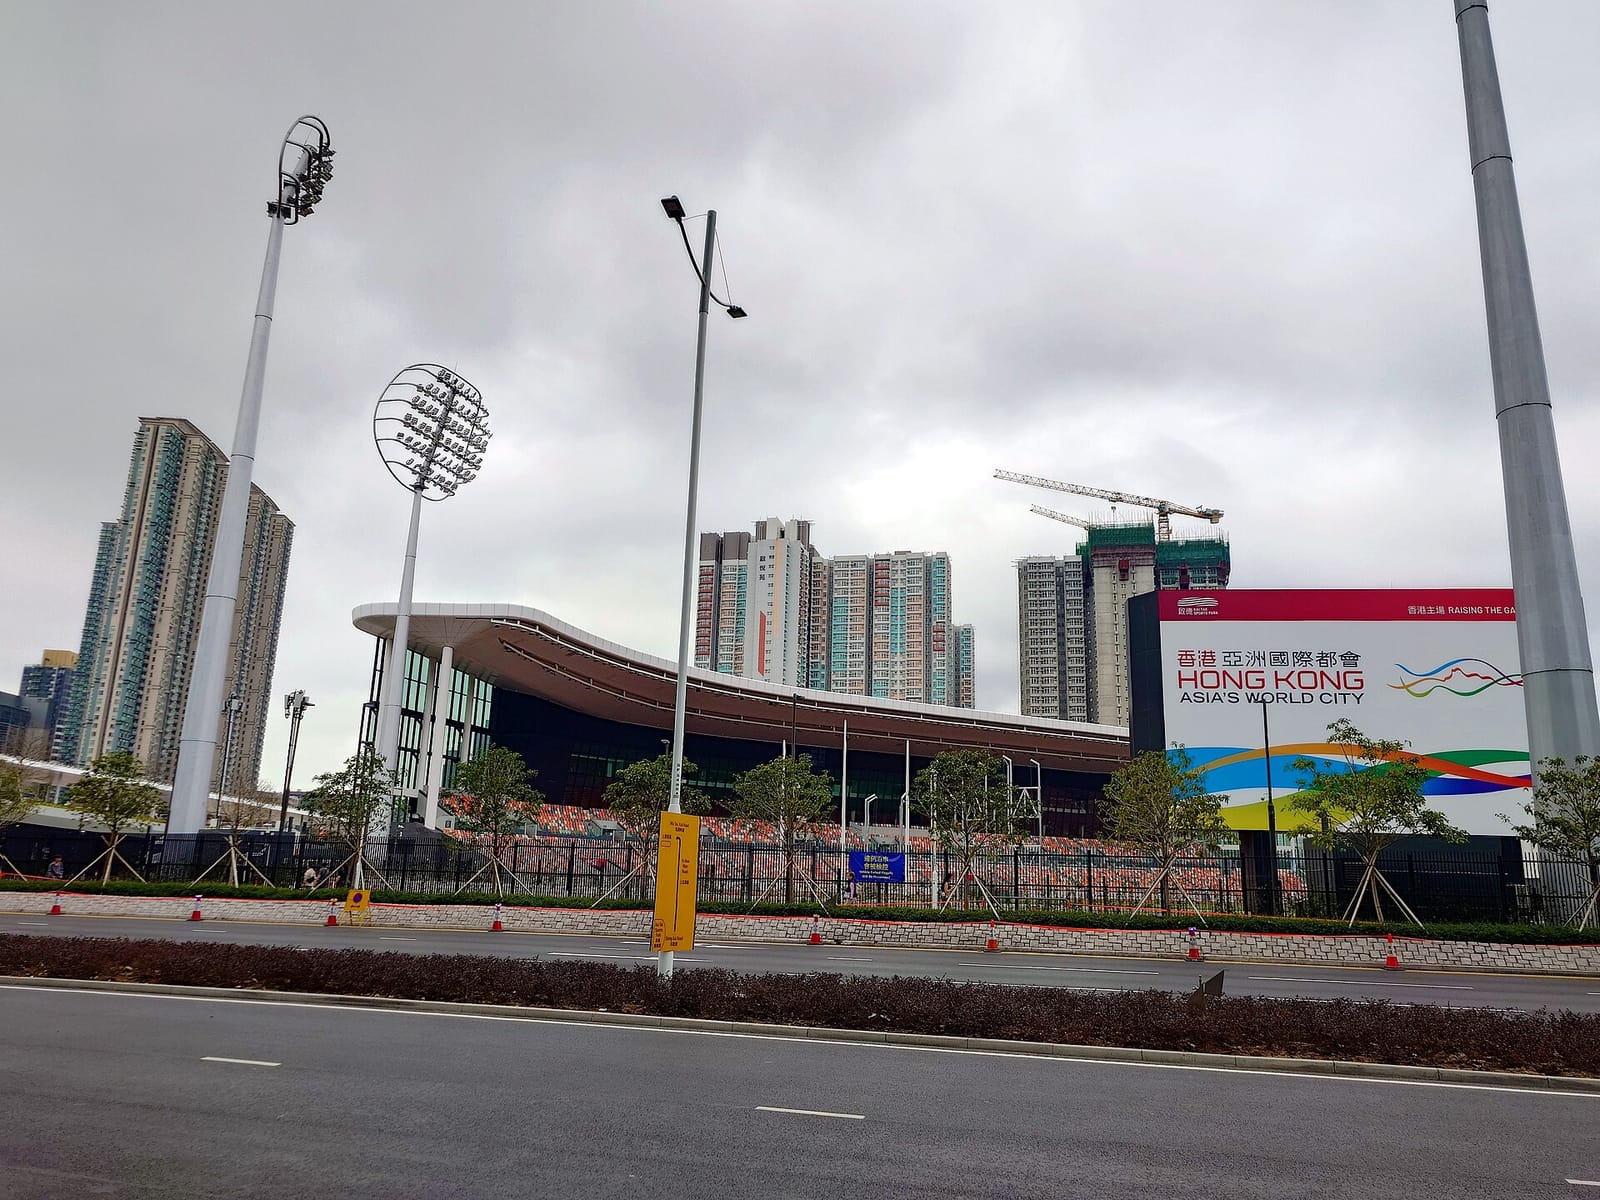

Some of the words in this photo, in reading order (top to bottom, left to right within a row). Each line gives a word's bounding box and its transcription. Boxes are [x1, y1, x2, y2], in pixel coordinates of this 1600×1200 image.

[1407, 605, 1445, 615] 香港主場
[1448, 606, 1483, 614] RAISING
[1485, 606, 1502, 614] THE
[1177, 650, 1217, 667] 香港
[1221, 651, 1361, 668] 亞洲國際都會
[1177, 670, 1265, 689] HONG
[1274, 670, 1364, 690] KONG
[1180, 692, 1240, 704] ASIA'S
[1245, 692, 1314, 704] WORLD
[1319, 692, 1365, 704] CITY
